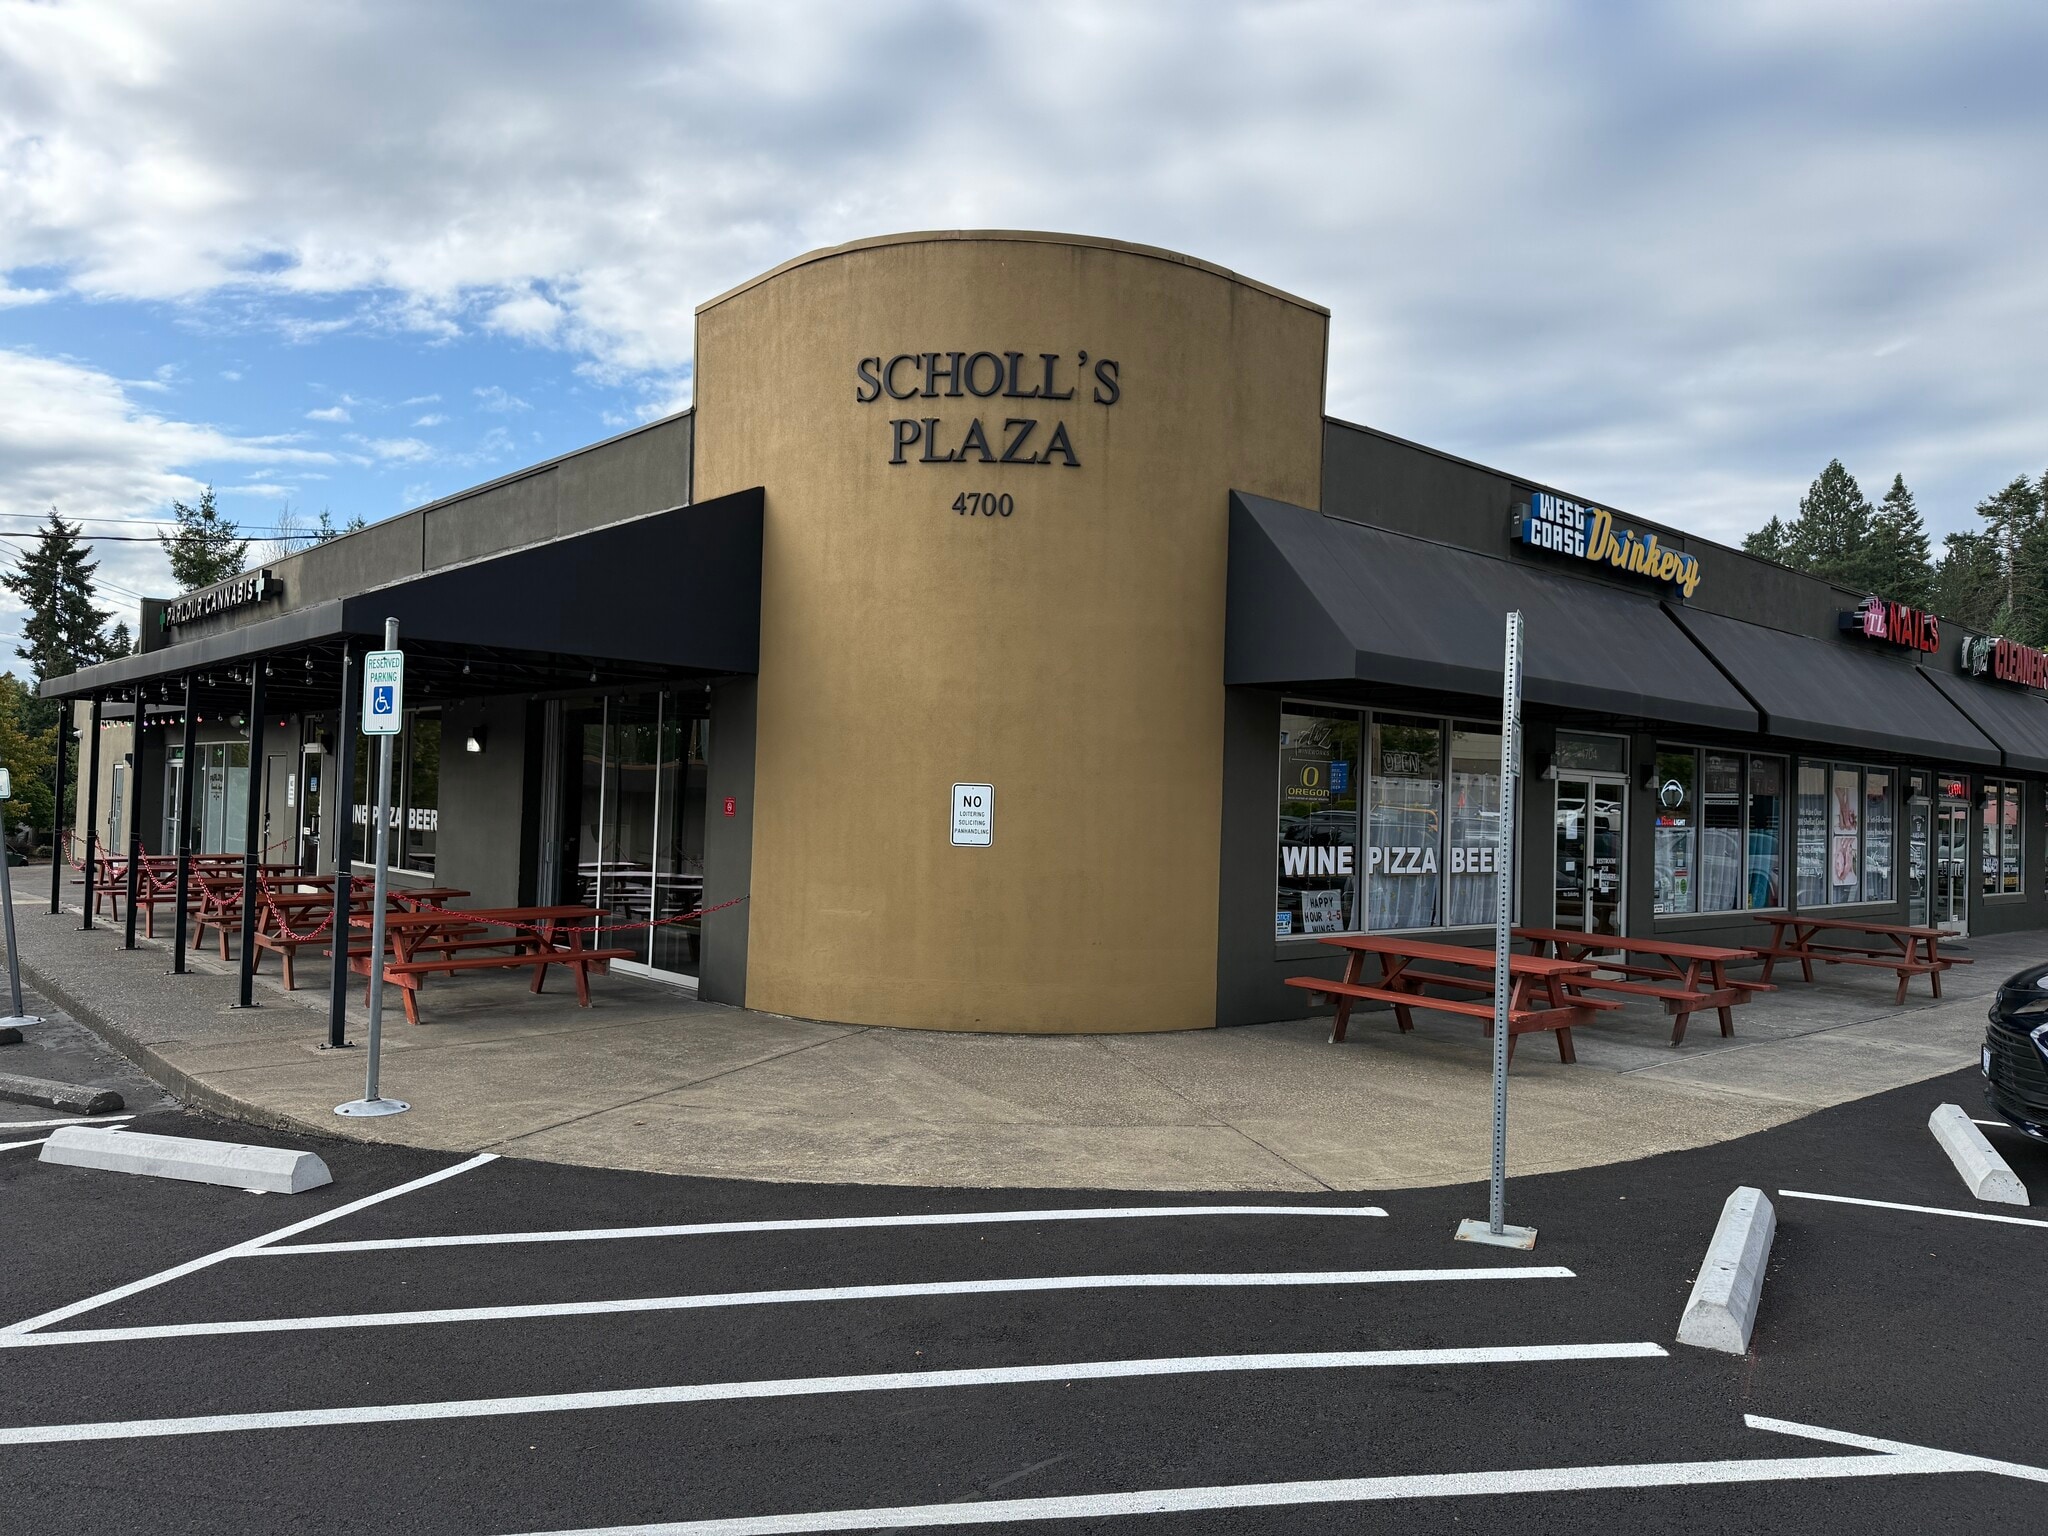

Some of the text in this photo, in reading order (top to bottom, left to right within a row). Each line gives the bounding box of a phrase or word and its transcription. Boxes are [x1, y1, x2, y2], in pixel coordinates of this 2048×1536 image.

[857, 350, 1120, 405] SCHOLL'S
[888, 417, 1081, 467] PLAZA
[952, 492, 1014, 517] 4700
[1539, 493, 1585, 530] WEST
[1530, 518, 1585, 558] COAST
[1586, 507, 1700, 598] Drinkery
[166, 577, 253, 626] PARLOUR CANNABIS
[1888, 601, 1940, 654] NAILS
[368, 657, 400, 669] RESERVED
[370, 671, 398, 683] PARKING
[1383, 752, 1419, 773] OPEN
[963, 795, 982, 808] NO
[1287, 786, 1330, 797] OREGON
[352, 804, 438, 831] INE PZA BEER
[1282, 846, 1353, 876] WINE
[1368, 846, 1438, 874] PIZZA
[1310, 897, 1333, 908] HAPPY
[1304, 911, 1322, 923] HOUR
